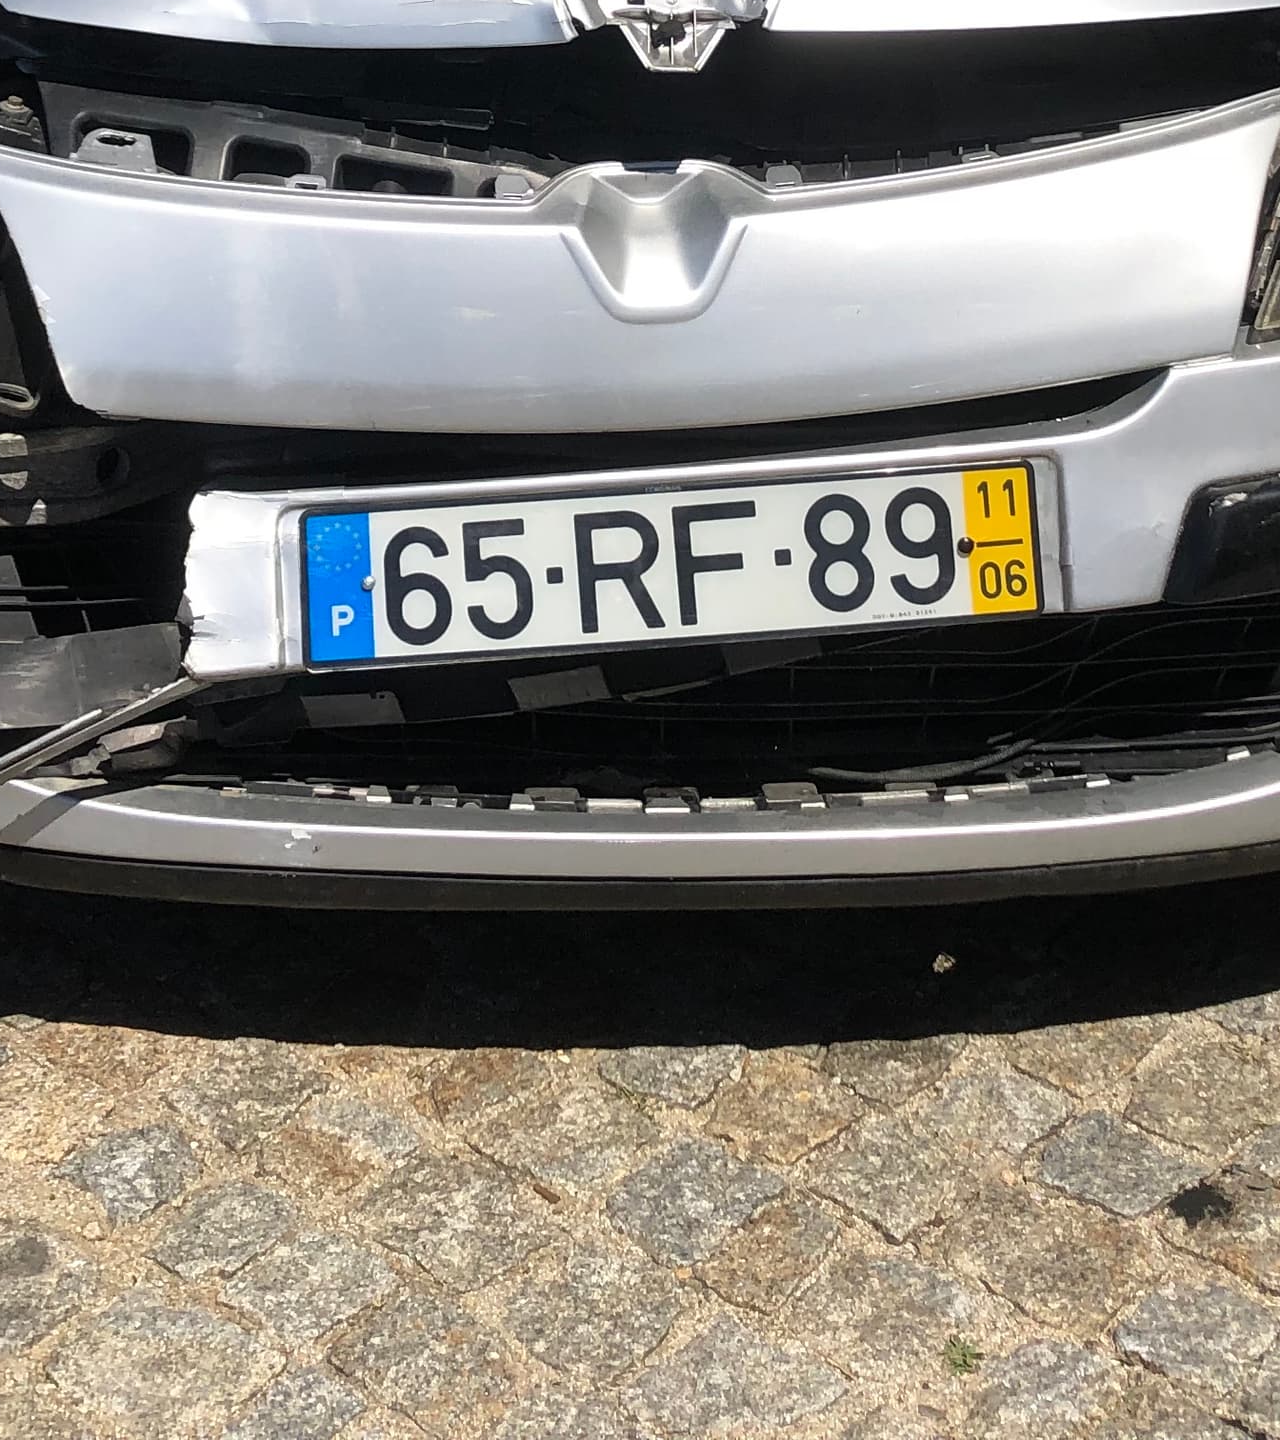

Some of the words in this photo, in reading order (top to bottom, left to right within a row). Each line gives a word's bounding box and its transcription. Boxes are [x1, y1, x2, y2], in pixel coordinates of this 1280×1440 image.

[977, 479, 1016, 518] 11
[979, 559, 1028, 599] 06
[331, 604, 355, 637] P
